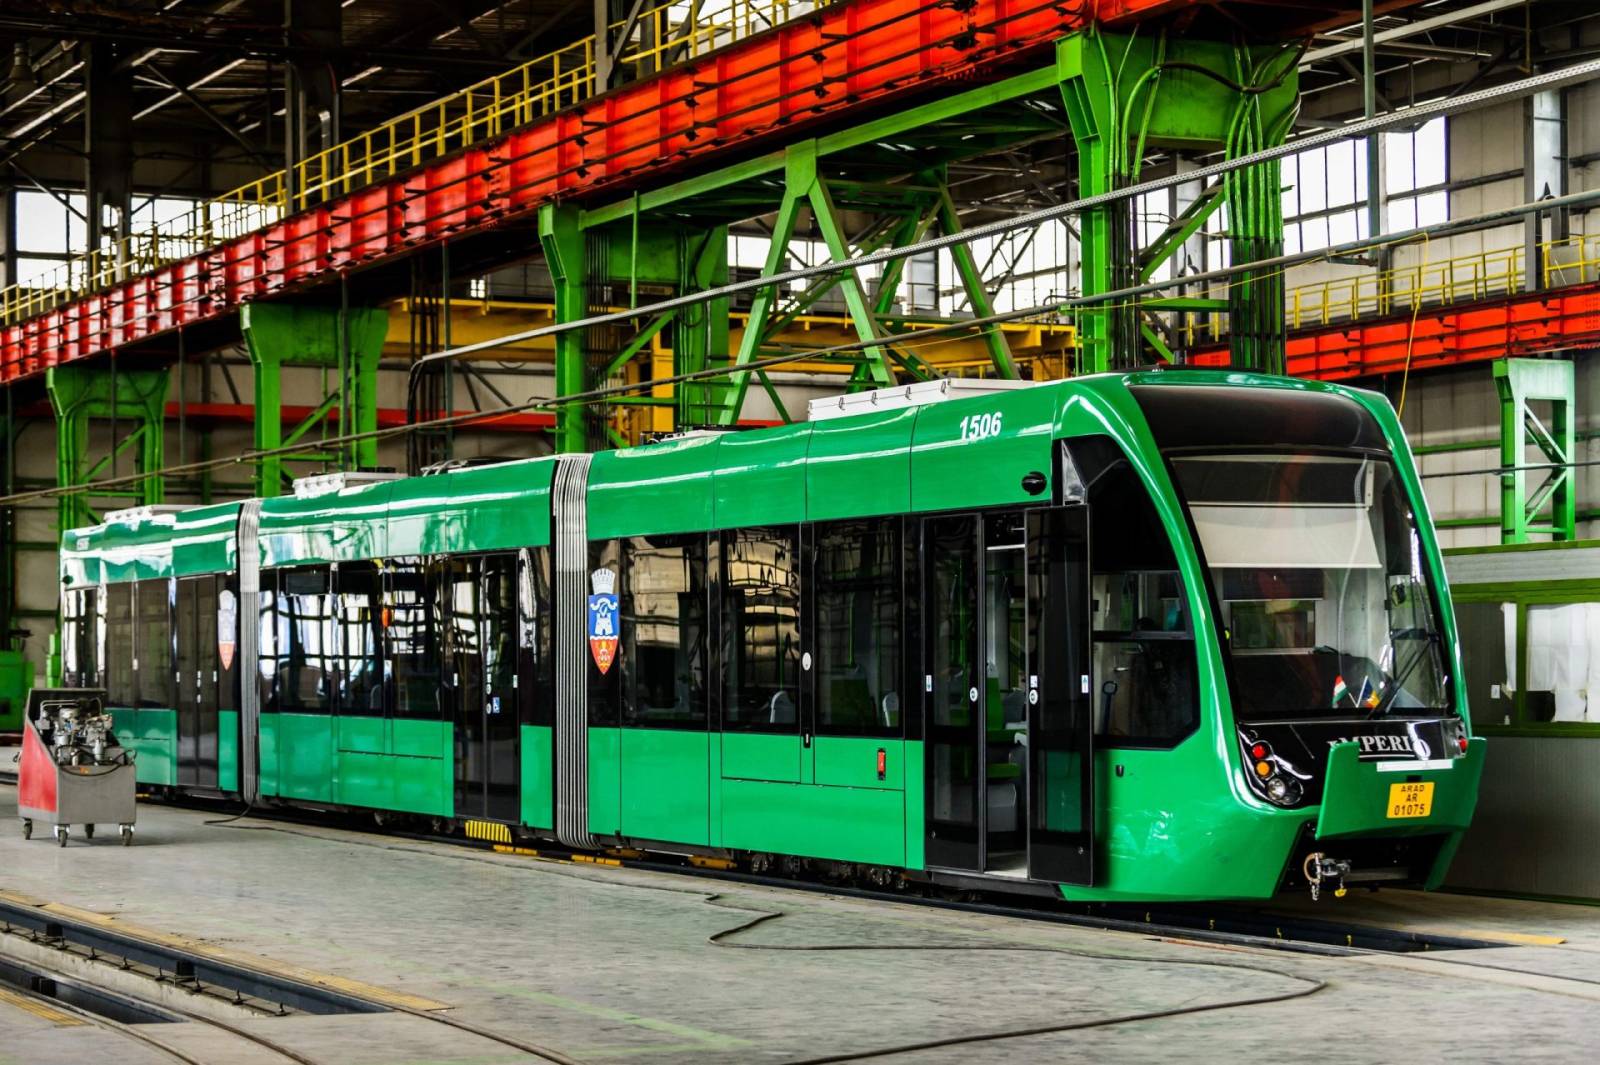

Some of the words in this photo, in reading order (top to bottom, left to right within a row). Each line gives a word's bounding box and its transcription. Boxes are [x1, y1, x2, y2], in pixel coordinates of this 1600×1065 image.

[960, 411, 1003, 443] 1506
[1401, 784, 1425, 792] ARAD
[1406, 793, 1418, 802] AR
[1394, 803, 1425, 816] 01075
